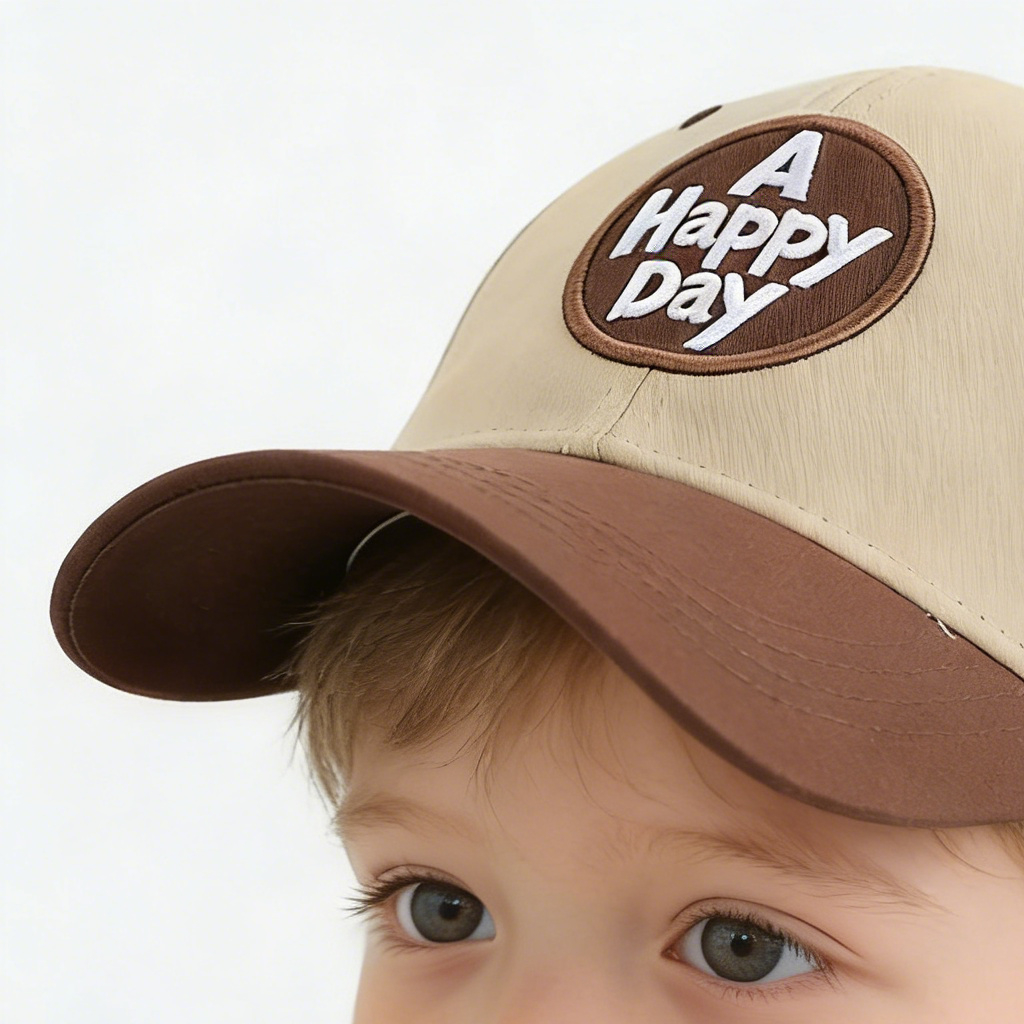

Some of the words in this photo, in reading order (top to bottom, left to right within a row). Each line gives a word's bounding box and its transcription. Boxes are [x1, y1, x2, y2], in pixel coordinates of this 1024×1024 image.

[727, 129, 824, 202] A
[608, 184, 894, 289] Happy
[606, 259, 790, 351] Day
